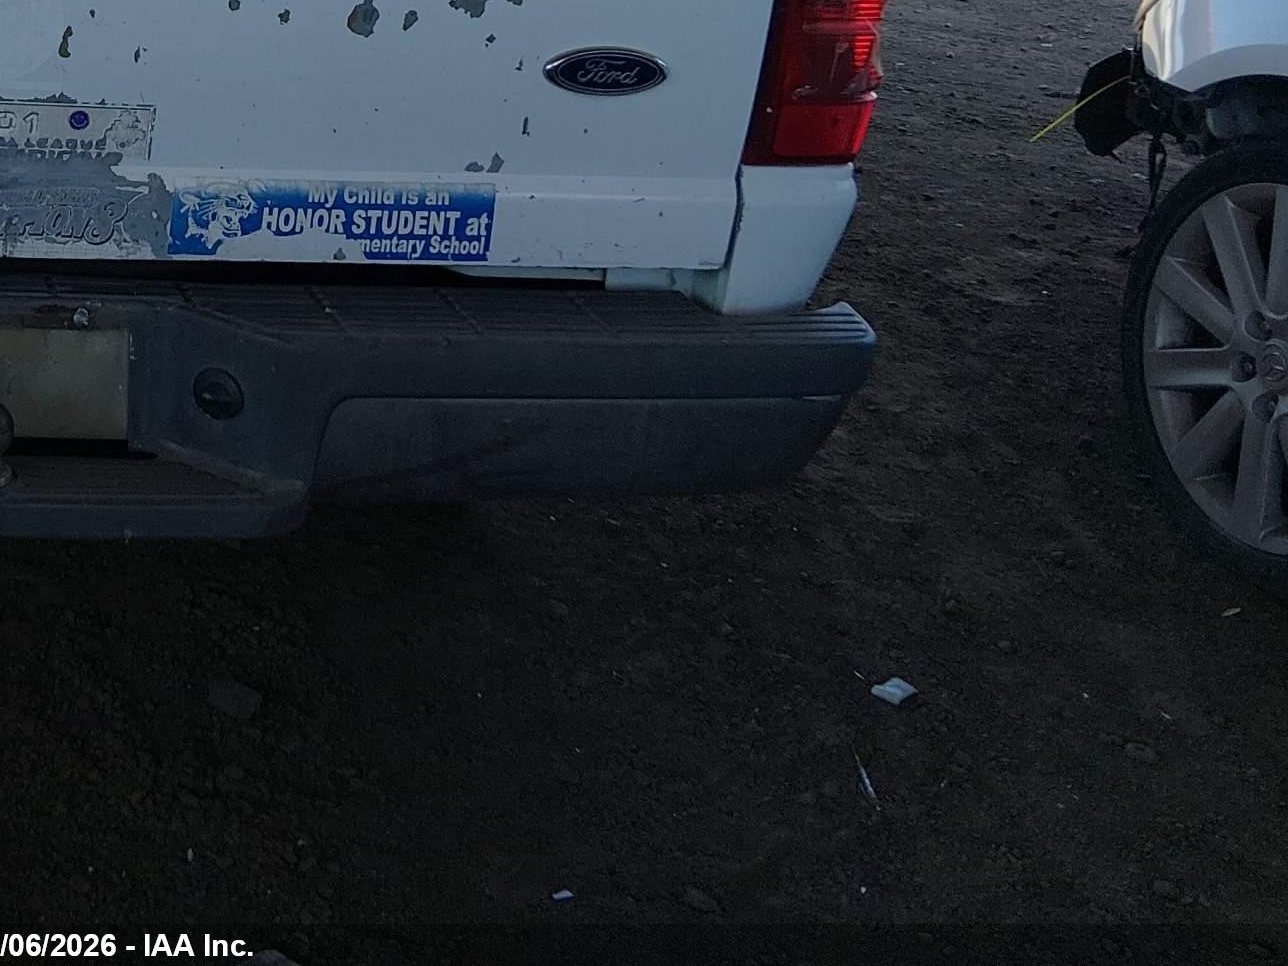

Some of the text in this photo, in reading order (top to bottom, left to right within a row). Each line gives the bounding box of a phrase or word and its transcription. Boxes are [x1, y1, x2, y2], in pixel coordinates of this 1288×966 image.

[576, 58, 641, 85] Ford
[307, 185, 337, 208] My
[343, 185, 394, 205] Child
[424, 189, 450, 206] an
[262, 206, 489, 236] HONOR STUDENT at
[360, 235, 486, 258] mentary School
